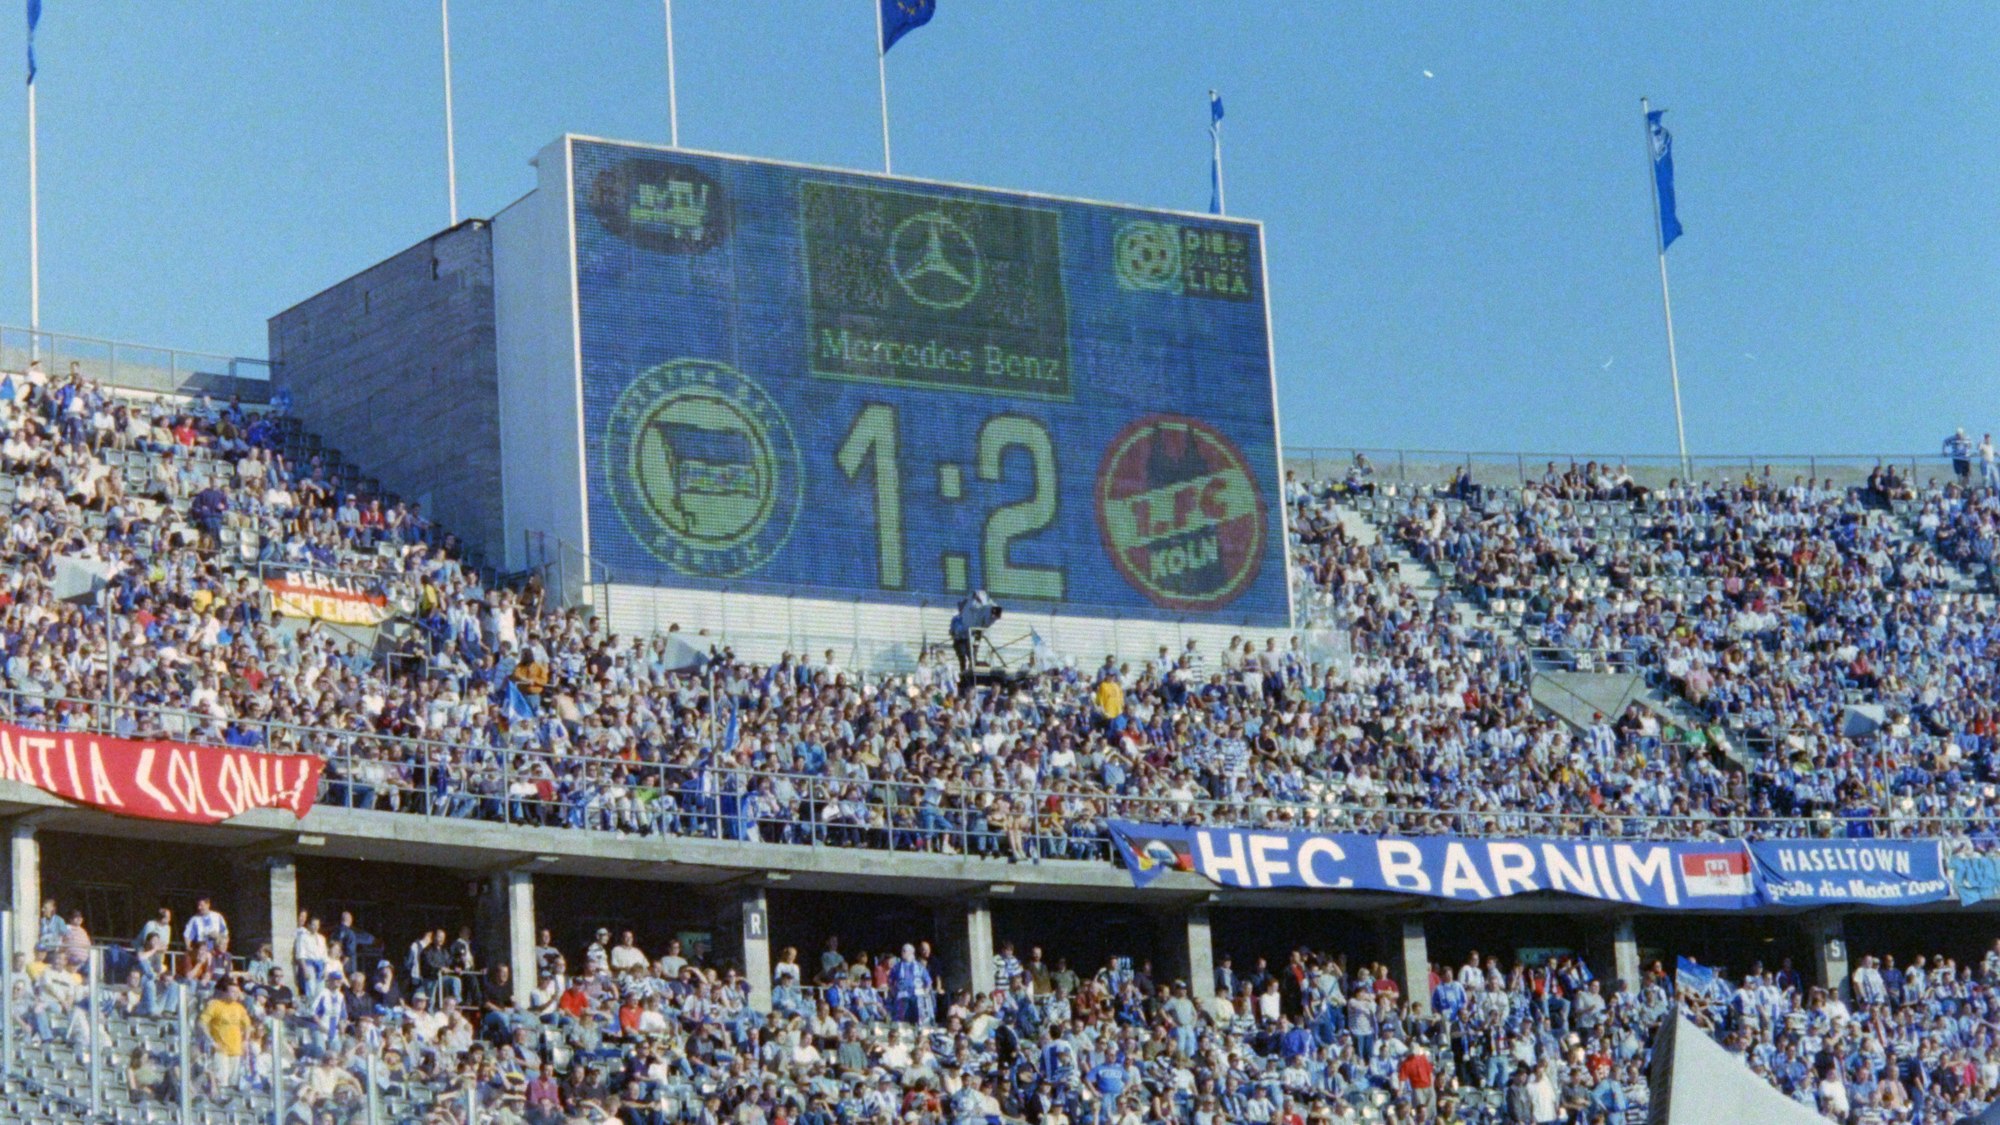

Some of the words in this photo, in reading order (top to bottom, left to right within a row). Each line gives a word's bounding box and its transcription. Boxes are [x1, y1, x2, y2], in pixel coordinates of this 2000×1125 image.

[1186, 270, 1249, 295] LIGA
[820, 327, 973, 373] Mercedes
[984, 344, 1060, 382] Benz
[0, 729, 125, 808] NTIA
[1196, 831, 1354, 889] HFC
[1376, 838, 1680, 906] BARNIM
[1778, 847, 1911, 874] HASELTOWN
[1818, 878, 1848, 898] die
[1848, 879, 1903, 899] Macht
[751, 912, 762, 935] R
[1830, 938, 1841, 958] S
